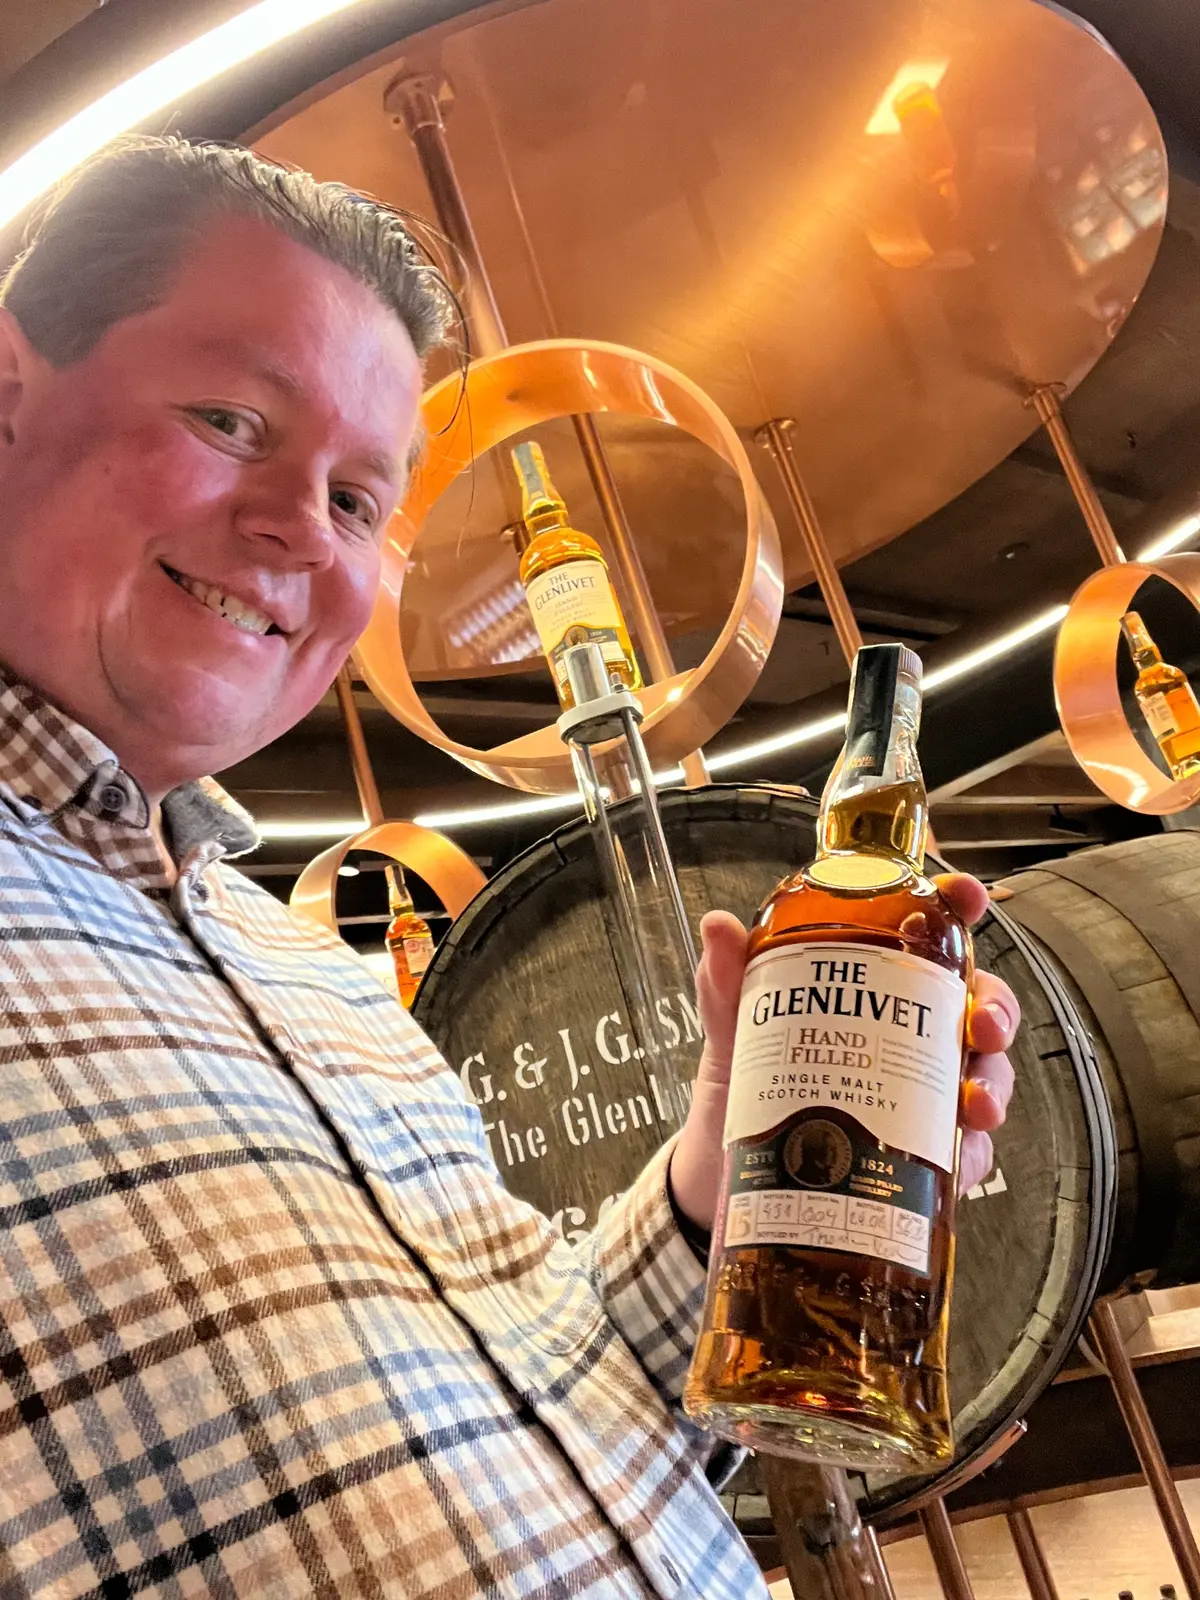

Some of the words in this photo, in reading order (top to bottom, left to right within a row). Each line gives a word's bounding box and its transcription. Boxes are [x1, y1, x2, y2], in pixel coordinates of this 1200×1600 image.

[548, 571, 569, 586] THE
[535, 576, 595, 611] GLENLIVET
[810, 961, 867, 985] THE
[798, 1028, 867, 1049] HAND
[513, 1042, 548, 1090] &
[557, 1028, 591, 1091] J.
[595, 1011, 646, 1066] G.
[789, 1047, 873, 1070] FILLED
[771, 1074, 831, 1086] SINGLE
[841, 1077, 885, 1093] MALT
[758, 1087, 820, 1101] SCOTCH
[830, 1092, 898, 1112] WHISKY
[860, 1157, 894, 1175] 1824
